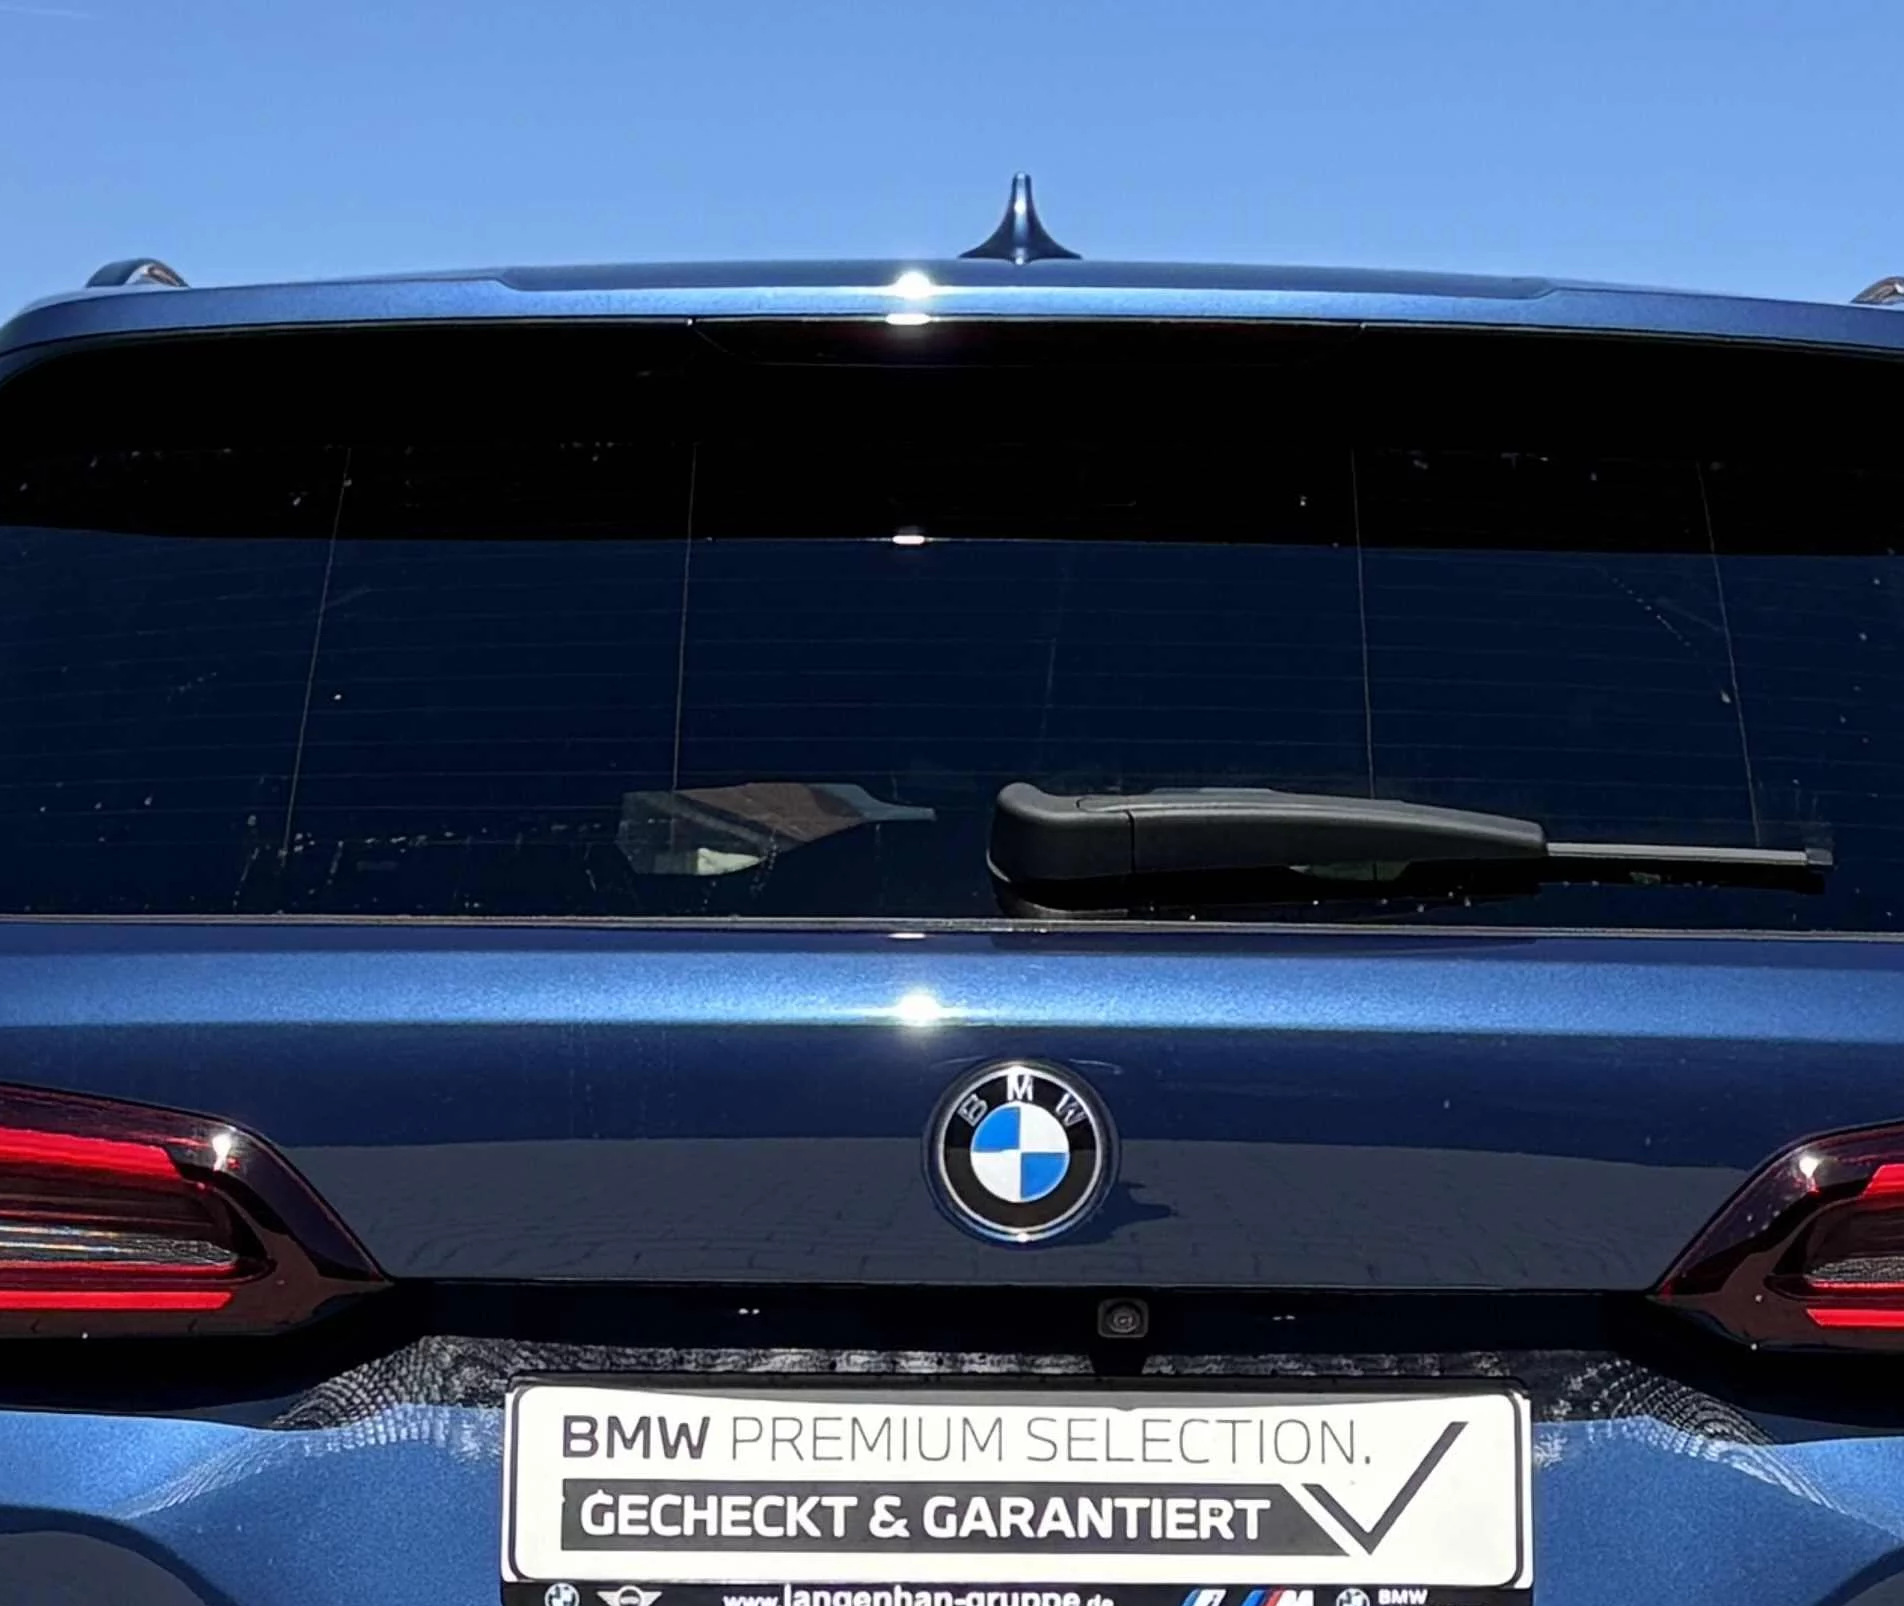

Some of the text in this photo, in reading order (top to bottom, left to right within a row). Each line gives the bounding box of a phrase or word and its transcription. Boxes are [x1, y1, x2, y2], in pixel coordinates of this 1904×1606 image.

[957, 1073, 1087, 1127] BMW
[562, 1415, 1371, 1465] BMW PREMIUM SELECTION.
[581, 1494, 1271, 1540] GECHECKT & GARANTIERT
[1377, 1588, 1428, 1605] BMW
